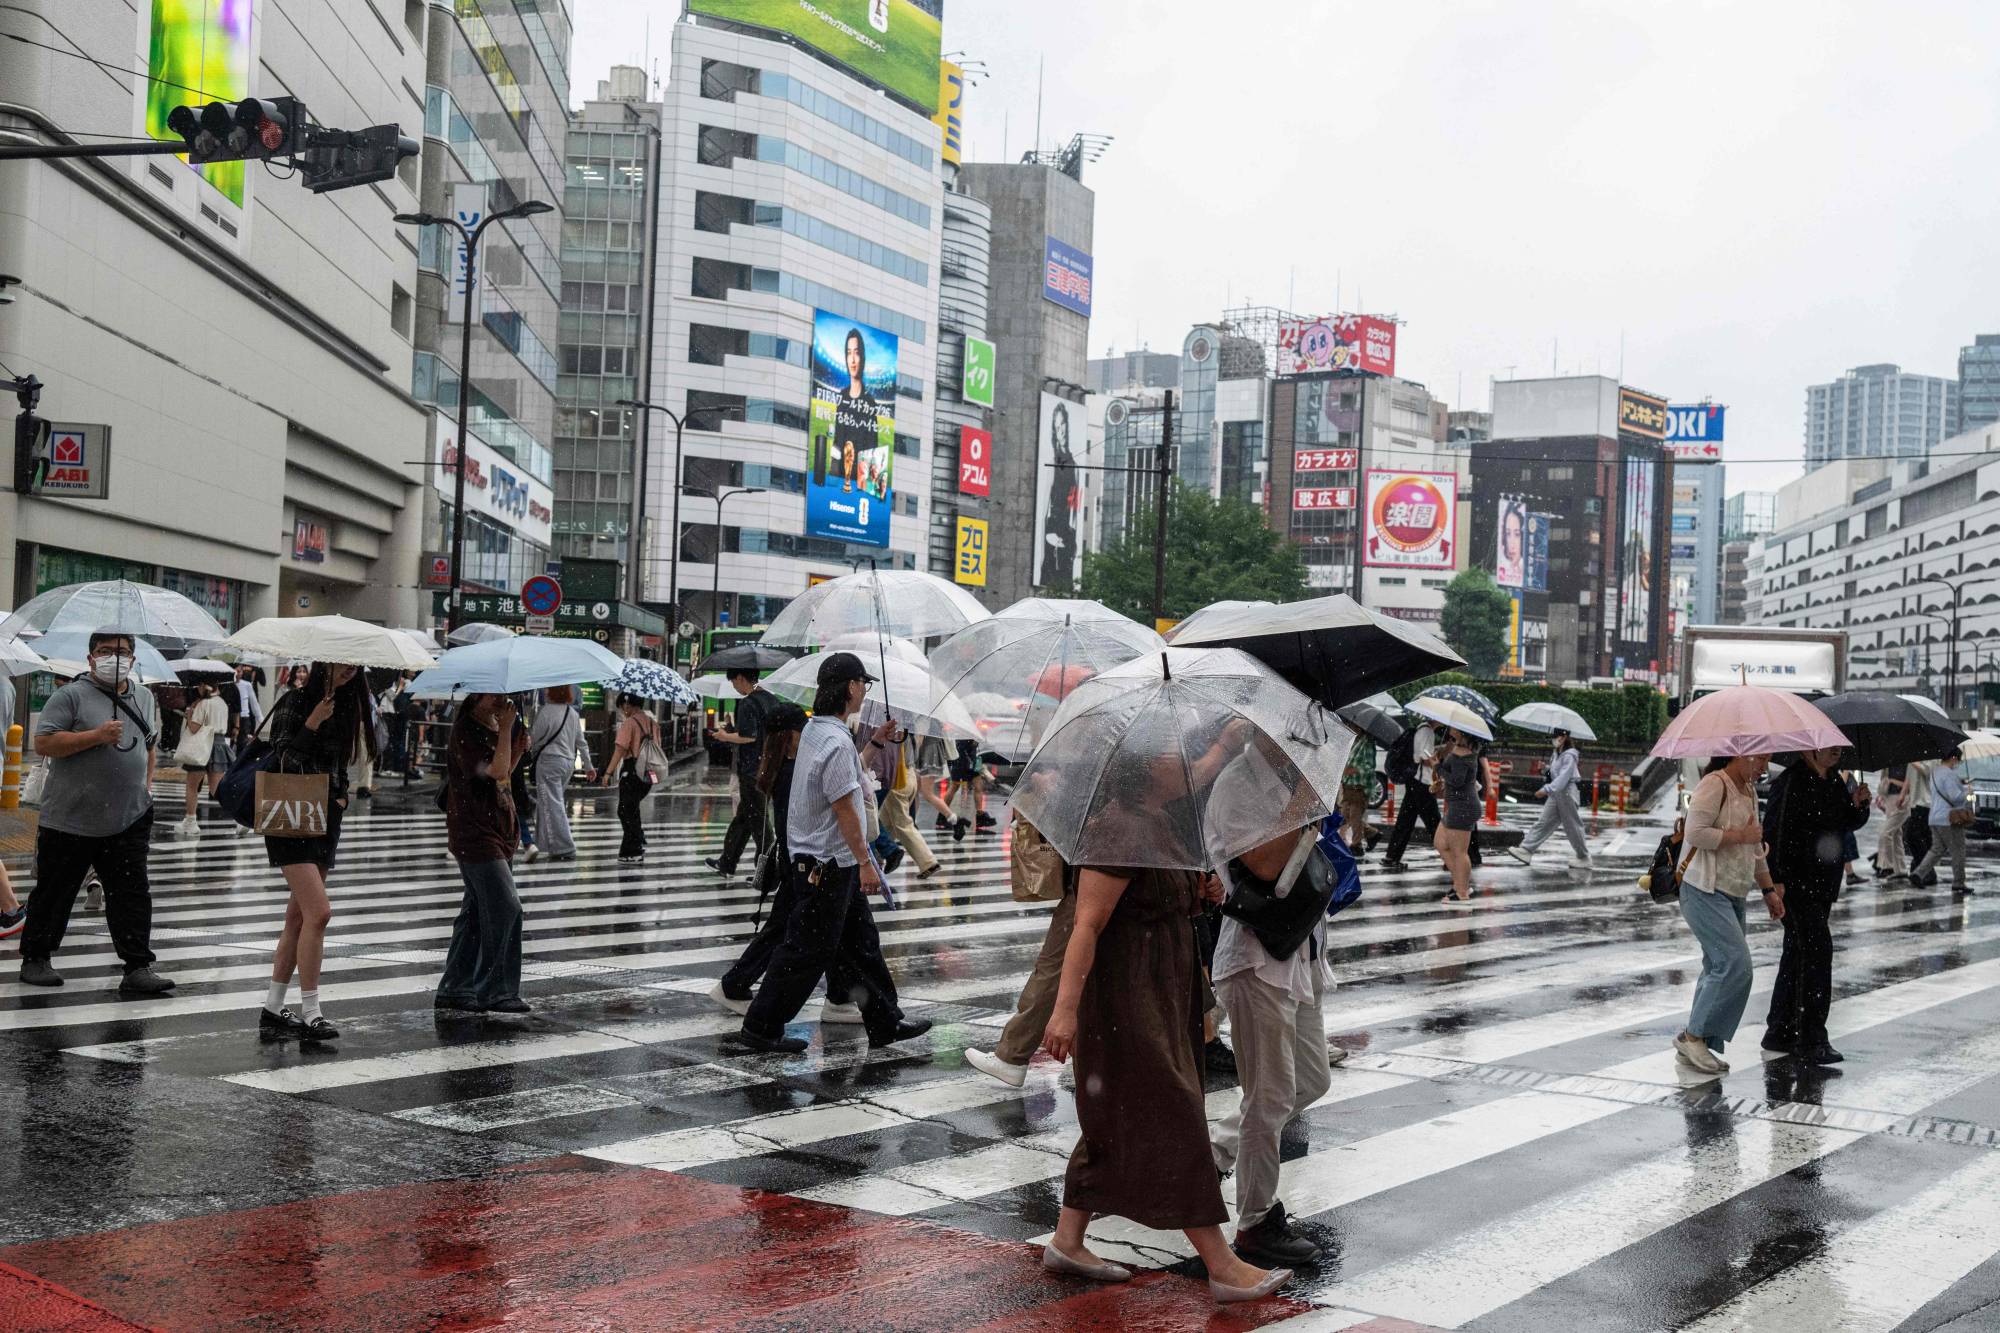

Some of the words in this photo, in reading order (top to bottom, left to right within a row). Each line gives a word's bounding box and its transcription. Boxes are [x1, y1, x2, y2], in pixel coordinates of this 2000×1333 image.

[1298, 451, 1354, 469] カラオケ
[962, 463, 988, 487] アコム
[829, 500, 856, 514] Hisense
[1385, 501, 1438, 529] 楽園
[960, 524, 984, 550] プロ
[959, 552, 982, 576] ミス
[465, 600, 490, 612] 地下
[560, 604, 586, 616] 近道
[261, 799, 328, 832] ZARA
